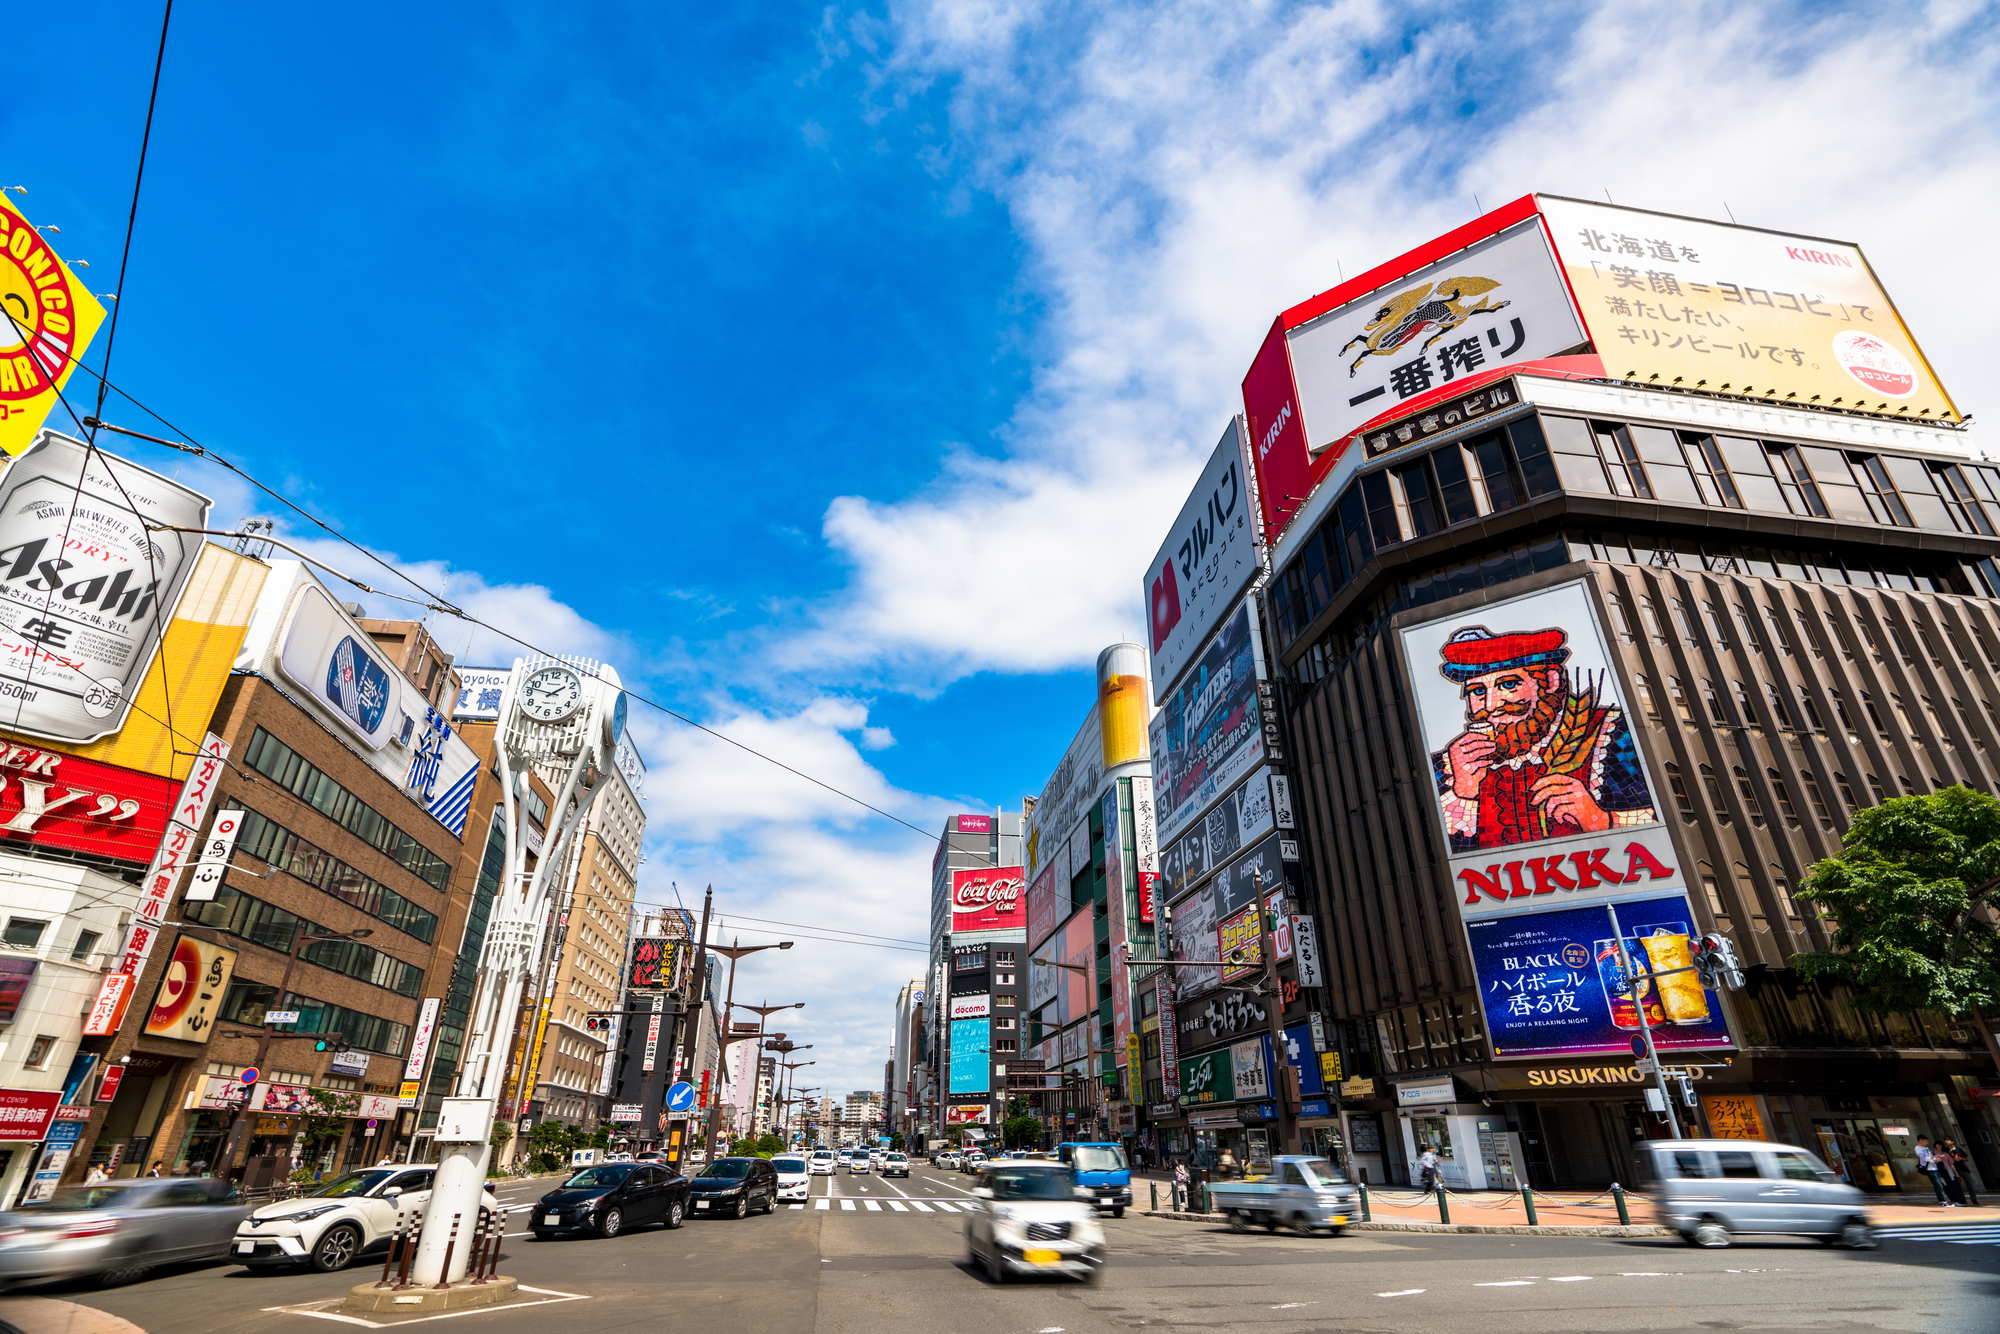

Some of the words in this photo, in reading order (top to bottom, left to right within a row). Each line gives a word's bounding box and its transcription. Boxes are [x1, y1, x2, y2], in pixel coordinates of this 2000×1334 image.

[1578, 228, 1700, 263] 北海道を
[1785, 246, 1853, 268] KIRIN
[1605, 295, 1745, 332] 満たしたい、
[1349, 317, 1526, 408] 一番搾り
[1618, 326, 1820, 370] キリンビールです。
[1842, 351, 1907, 372] 北海道の
[1856, 368, 1910, 385] ヨロコビール
[1259, 401, 1292, 461] KIRIN
[1371, 388, 1511, 452] すすきのビル
[36, 507, 65, 520] ASAHI
[72, 508, 129, 534] BREWERIES
[129, 533, 154, 561] LIMITED
[1179, 461, 1237, 582] マルハン
[1185, 515, 1243, 612] 人生にヨロコビを
[0, 538, 161, 622] Asahi
[20, 617, 72, 649] 生
[5, 657, 50, 676] 生ビール
[540, 673, 549, 681] 11
[564, 675, 569, 683] 1
[526, 689, 533, 697] 9
[1182, 659, 1233, 761] FIGHTERS
[0, 741, 61, 776] ER
[405, 726, 443, 803] 純
[1226, 833, 1240, 854] EVE
[1174, 867, 1195, 889] Lounge
[1240, 852, 1264, 879] HIBIKI
[1457, 842, 1675, 904] NIKKA
[957, 878, 1018, 903] Coca-Cola
[996, 901, 1016, 911] Coke
[1031, 872, 1050, 910] カラオケ
[634, 941, 659, 985] かに
[1503, 953, 1562, 970] BLACK
[1566, 949, 1586, 957] 北海道
[1284, 981, 1298, 1003] 2F
[1490, 972, 1586, 993] ハイボール
[89, 977, 120, 1031] ほっとハウス
[955, 1006, 985, 1014] docomo
[1507, 989, 1580, 1016] 香る夜
[1188, 1055, 1212, 1092] エイブル
[1528, 1065, 1646, 1086] SUSUKINO
[1724, 1100, 1746, 1139] タイムズ
